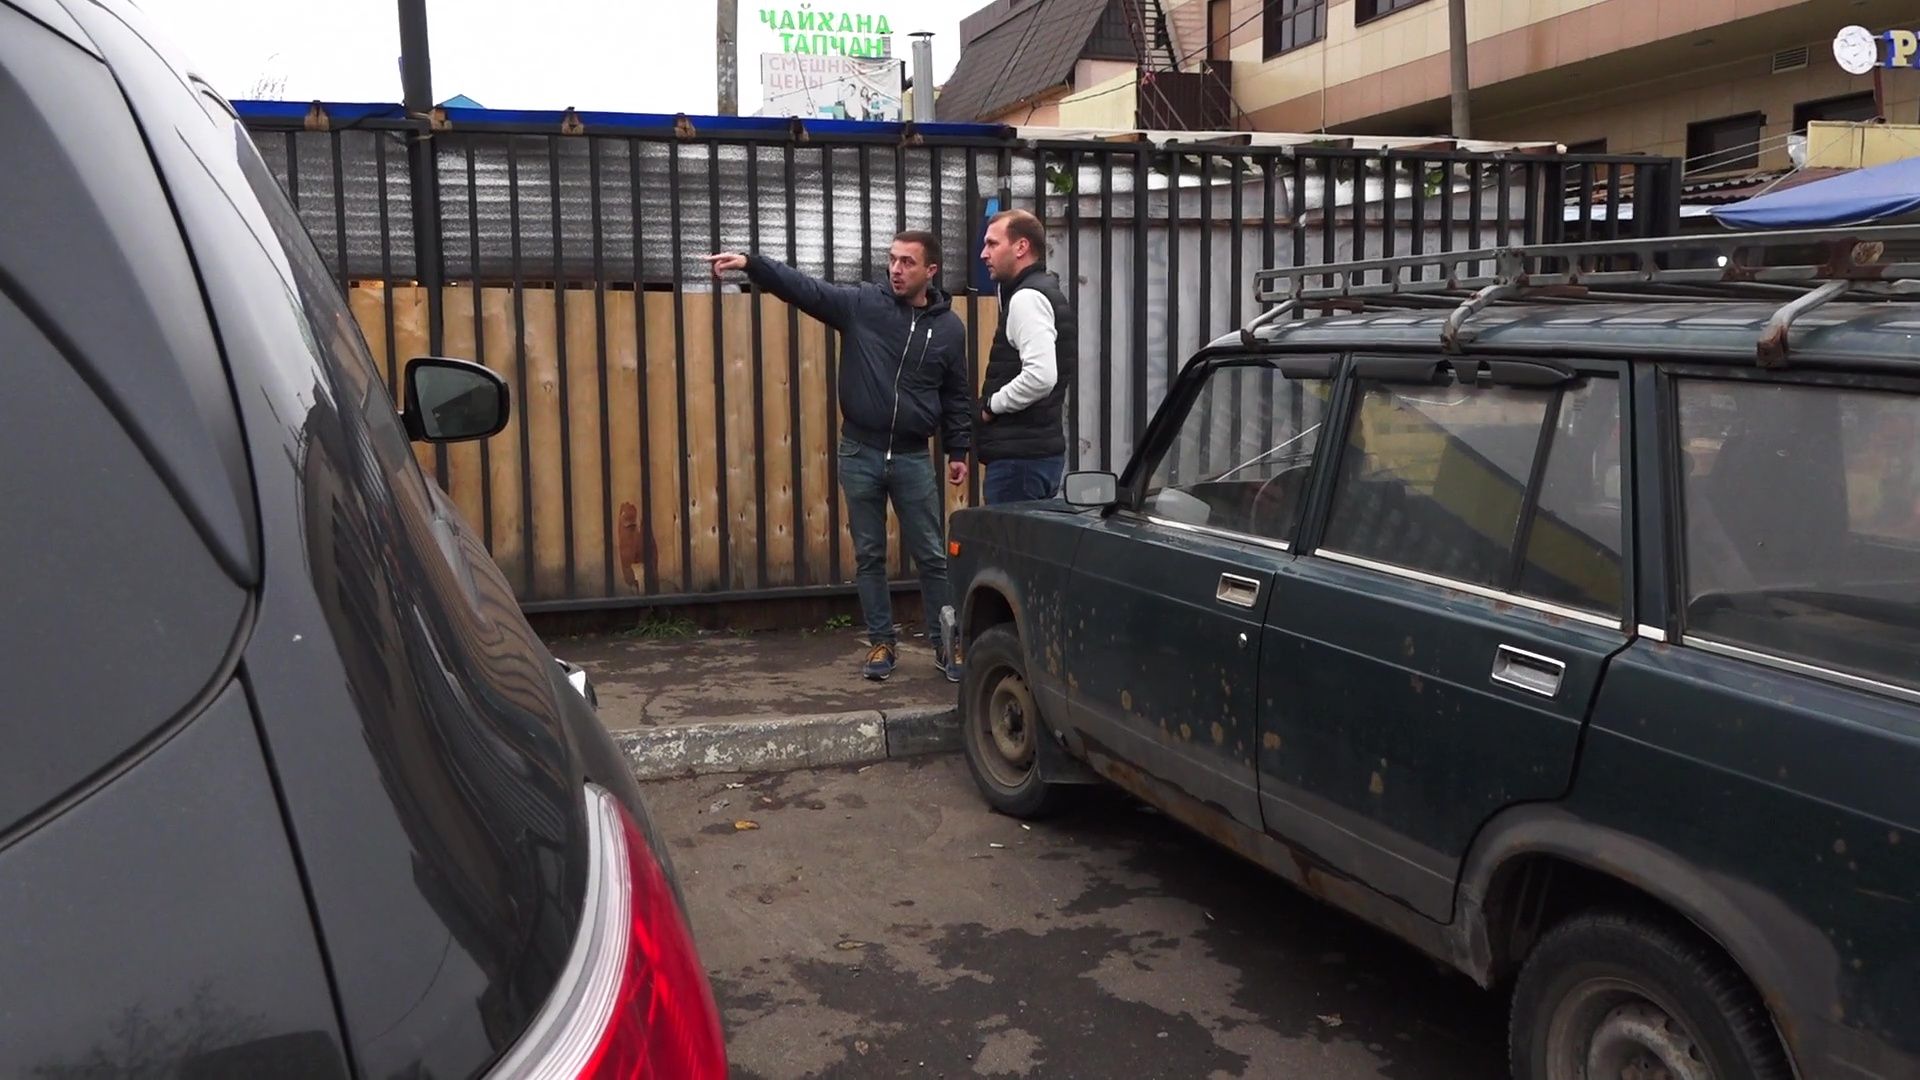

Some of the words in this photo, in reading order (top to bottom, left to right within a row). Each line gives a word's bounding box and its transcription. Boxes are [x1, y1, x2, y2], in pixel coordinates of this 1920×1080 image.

[759, 3, 892, 34] ЧАЙХАНА
[779, 33, 883, 57] ТАПЧАН
[770, 74, 823, 89] ЦЕНЫ
